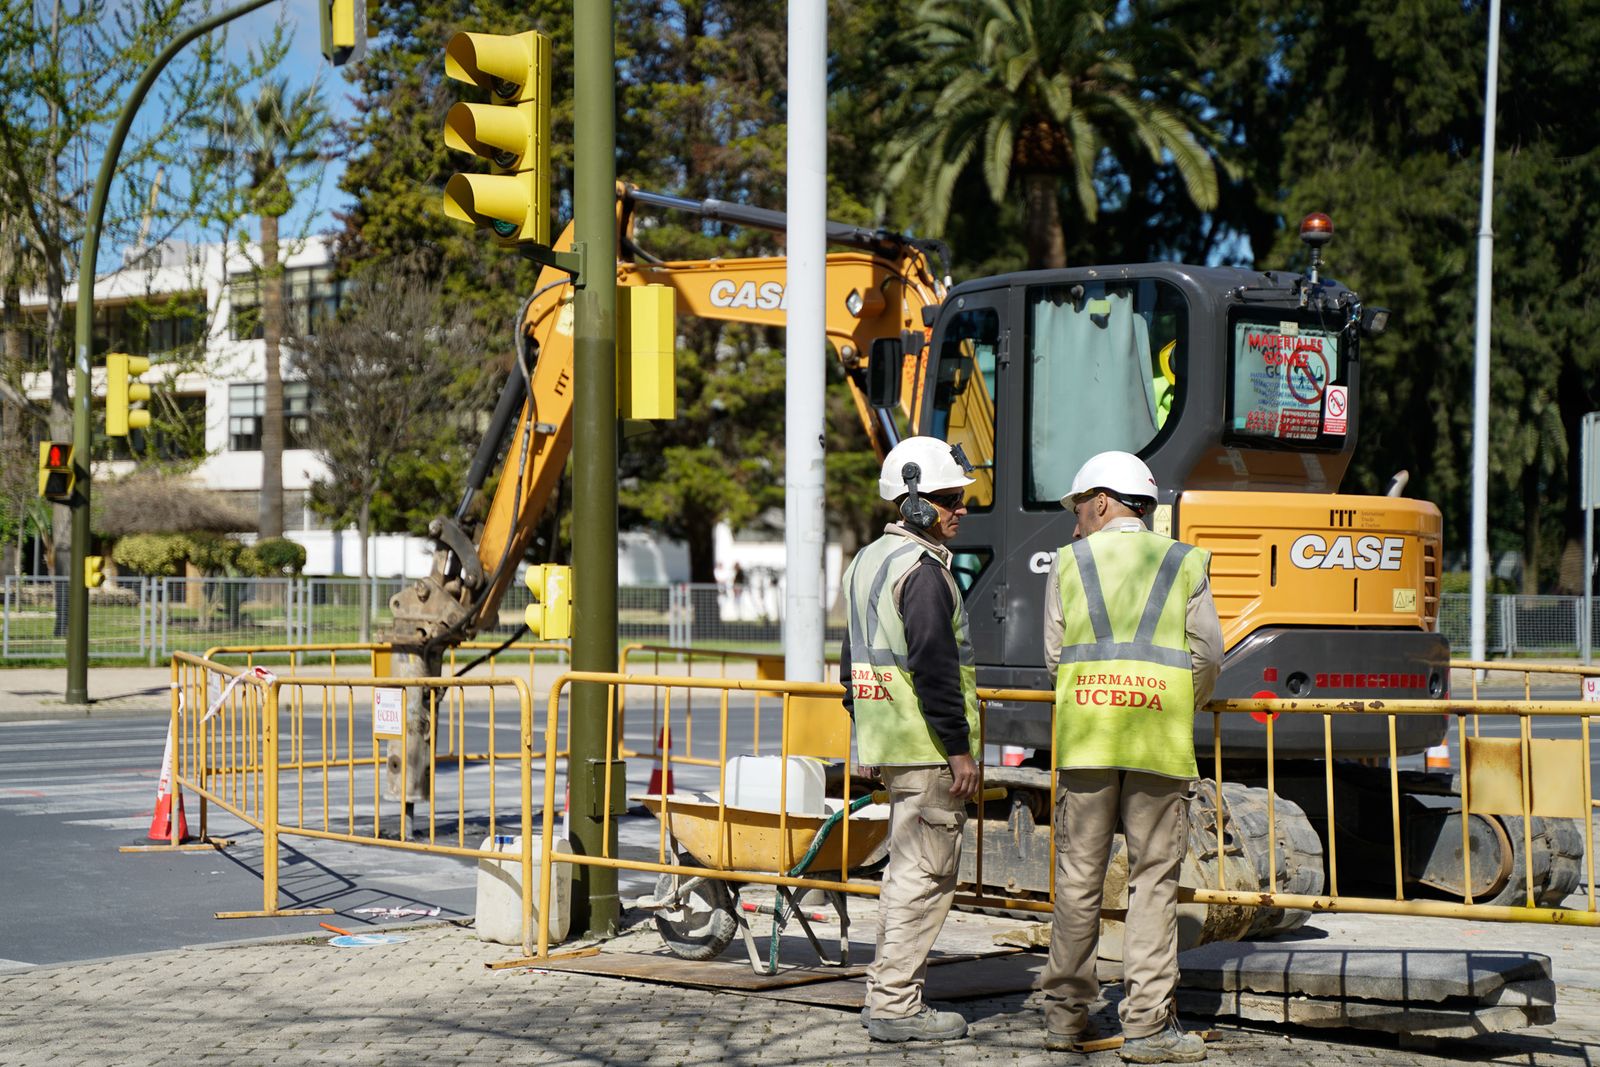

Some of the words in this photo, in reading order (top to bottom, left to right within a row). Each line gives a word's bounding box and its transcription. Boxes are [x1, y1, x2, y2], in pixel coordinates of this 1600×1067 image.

[1248, 333, 1323, 352] MATERIALES
[1290, 534, 1405, 571] CASE
[1076, 674, 1167, 690] HERMANOS
[1075, 689, 1163, 711] UCEDA
